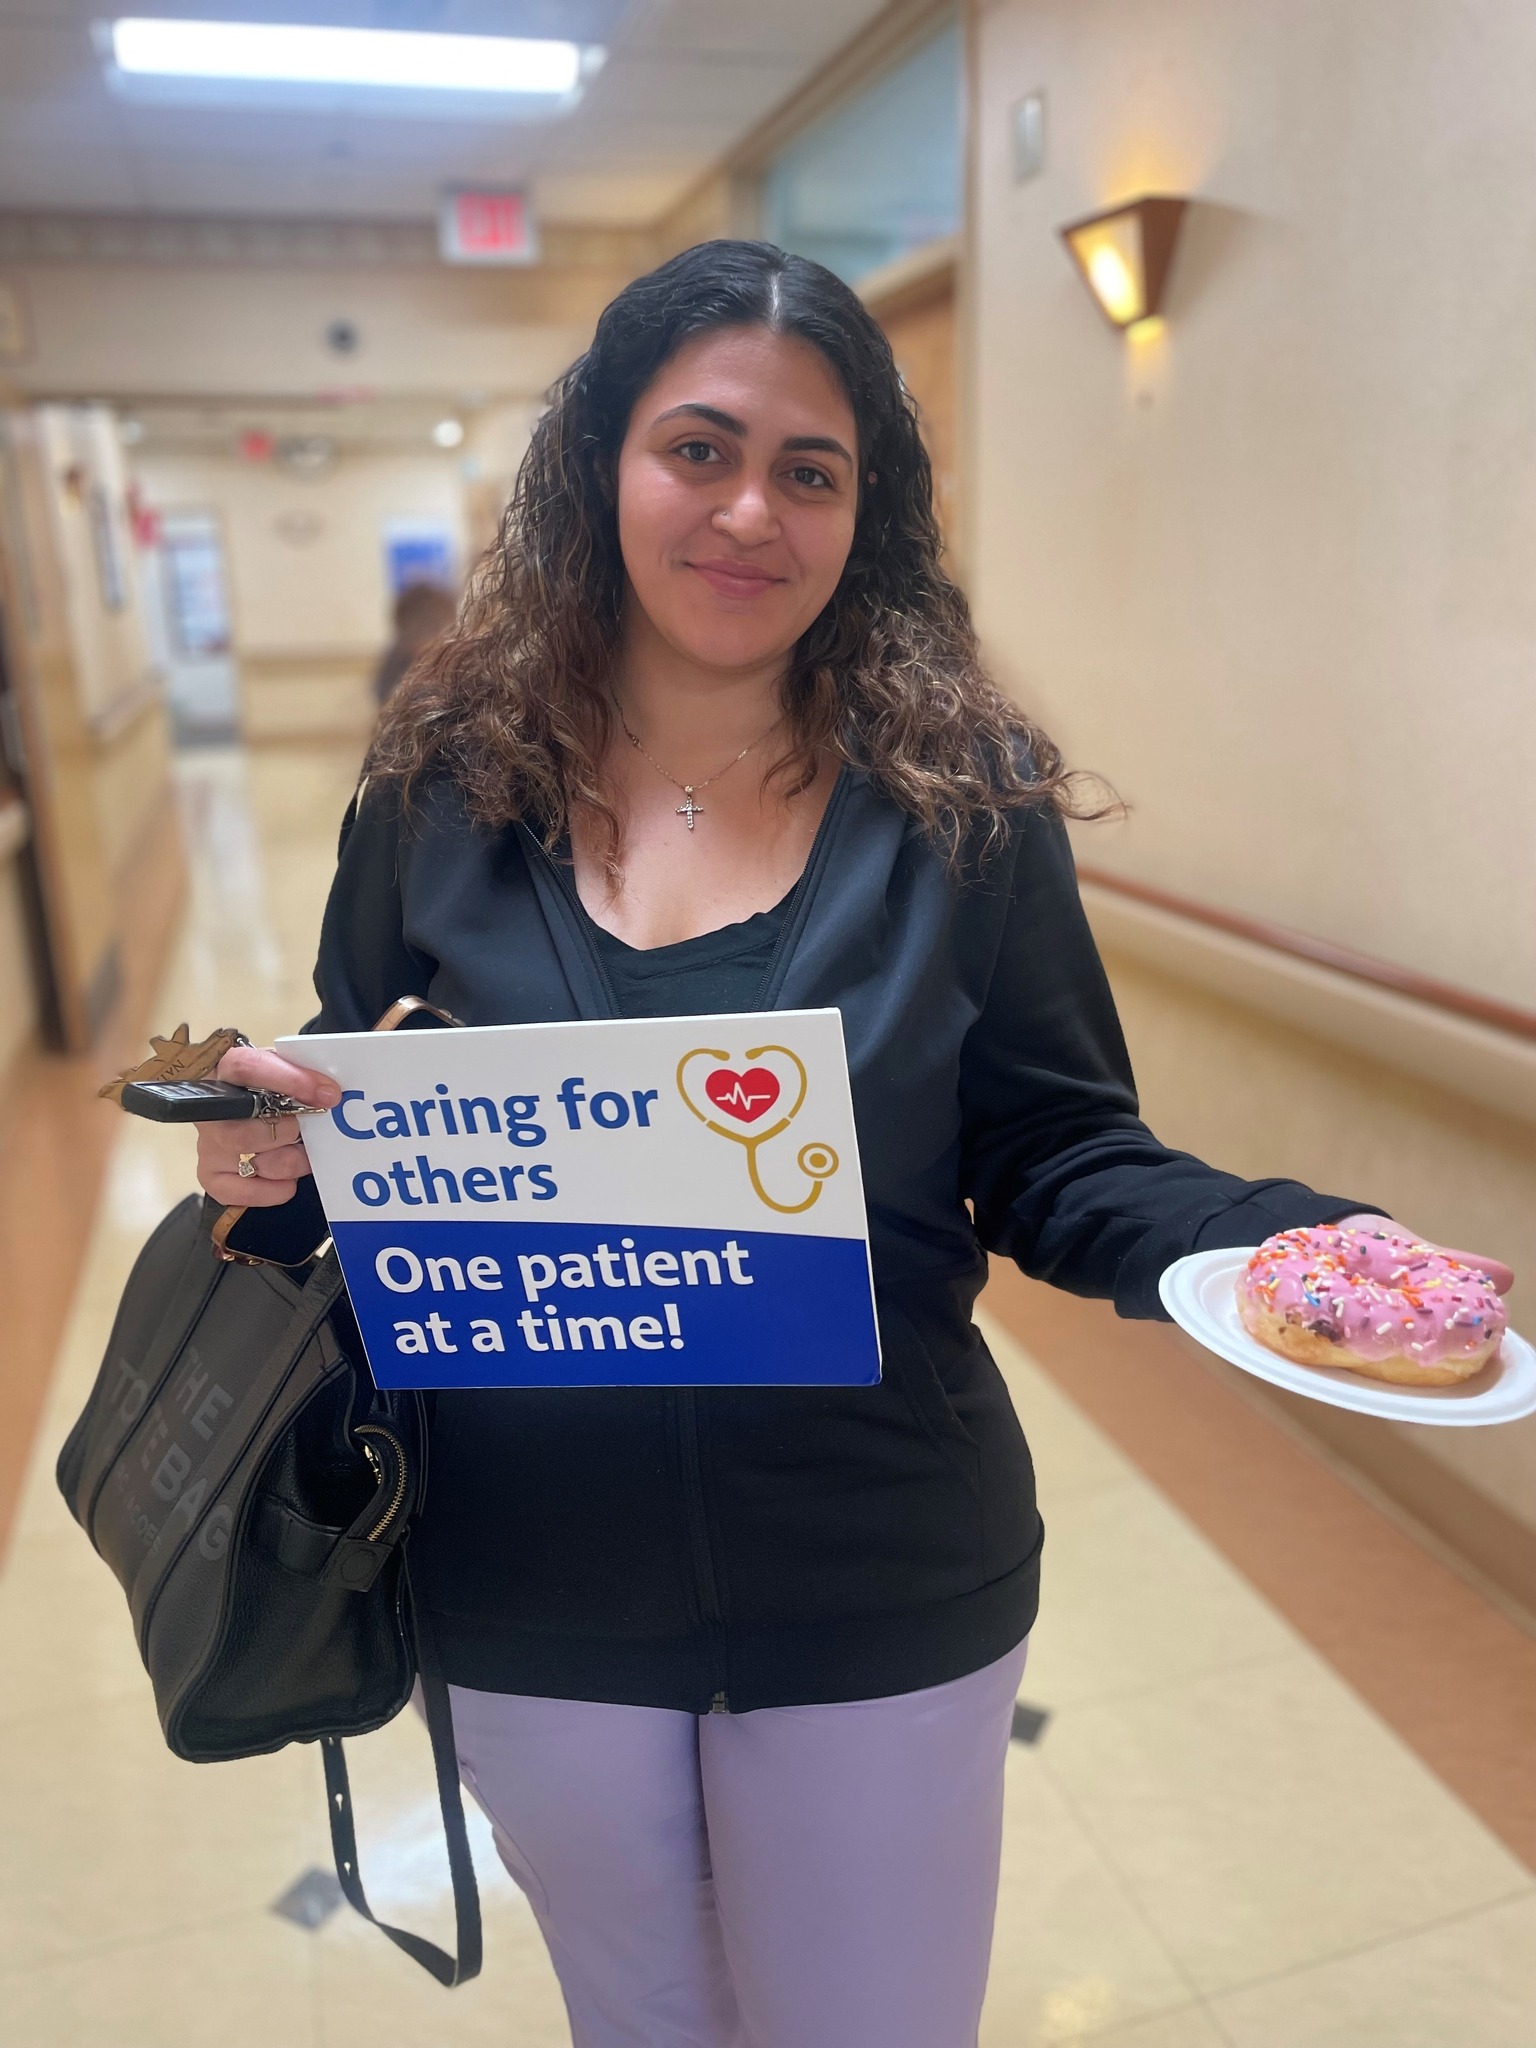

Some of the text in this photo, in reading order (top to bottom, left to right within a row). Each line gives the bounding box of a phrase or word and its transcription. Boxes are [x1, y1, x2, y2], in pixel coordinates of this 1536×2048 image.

[333, 1077, 658, 1147] Caring for
[351, 1155, 558, 1207] others
[375, 1238, 753, 1301] One patient
[395, 1303, 685, 1354] at a time!
[172, 1345, 234, 1441] THE
[152, 1442, 234, 1561] BAG
